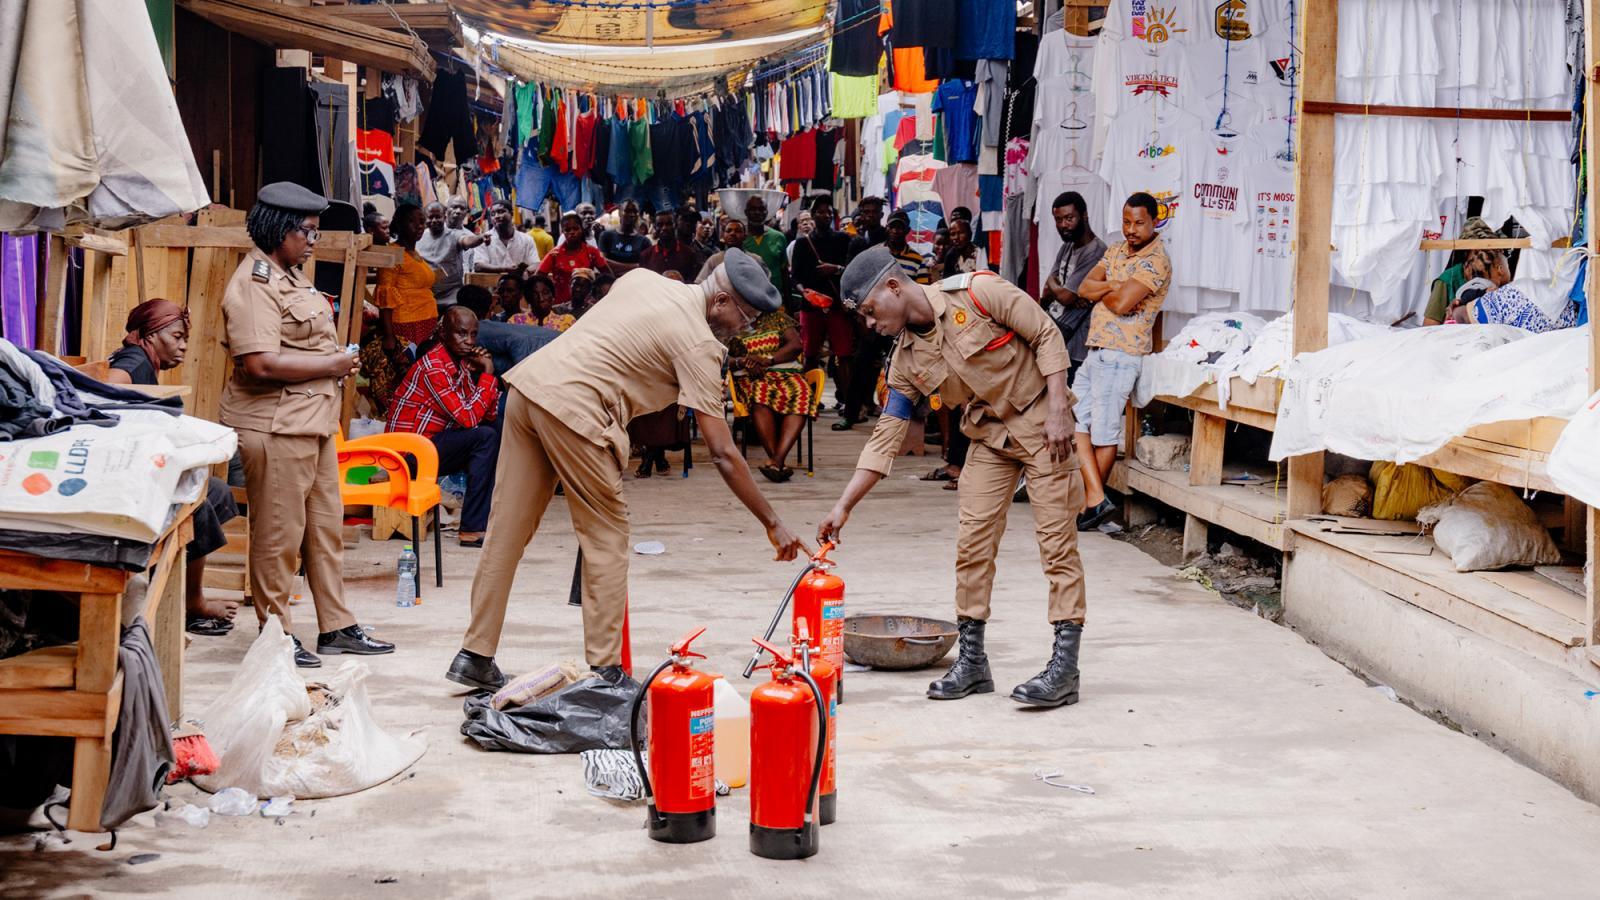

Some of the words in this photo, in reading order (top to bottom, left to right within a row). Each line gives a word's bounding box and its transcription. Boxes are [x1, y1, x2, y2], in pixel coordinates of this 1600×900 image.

[1194, 183, 1239, 201] COMMUNI
[1257, 192, 1271, 201] IT'S
[1273, 193, 1296, 202] MOSC
